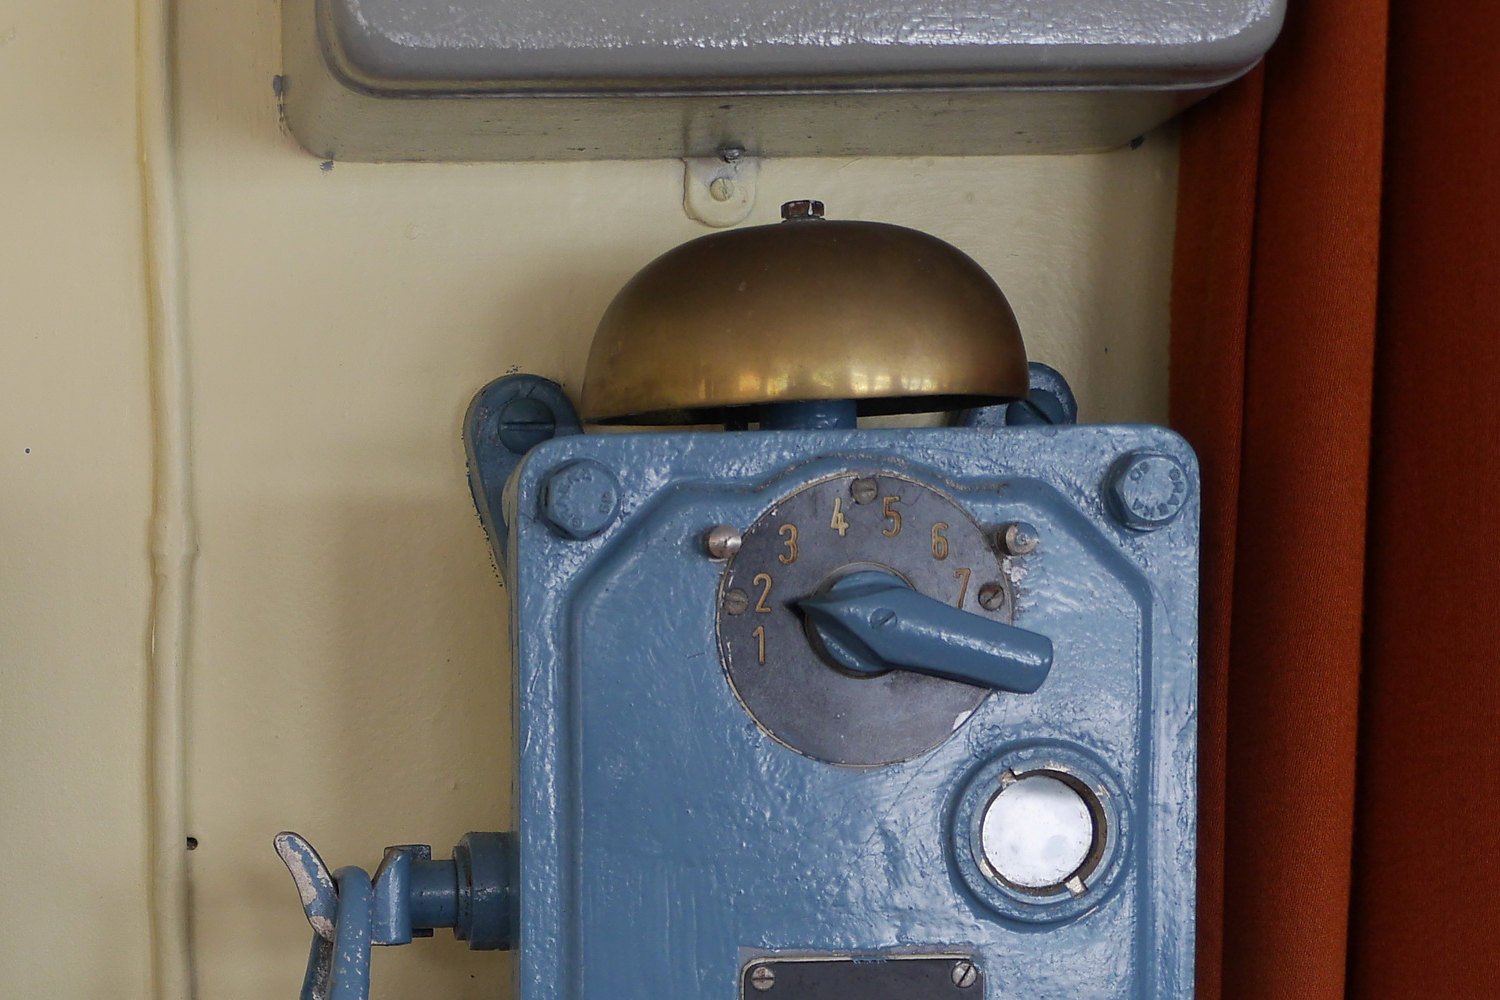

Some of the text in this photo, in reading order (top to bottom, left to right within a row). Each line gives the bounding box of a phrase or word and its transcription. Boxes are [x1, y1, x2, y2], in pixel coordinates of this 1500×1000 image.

[753, 496, 970, 663] 1 2 3 4 5 6 7
